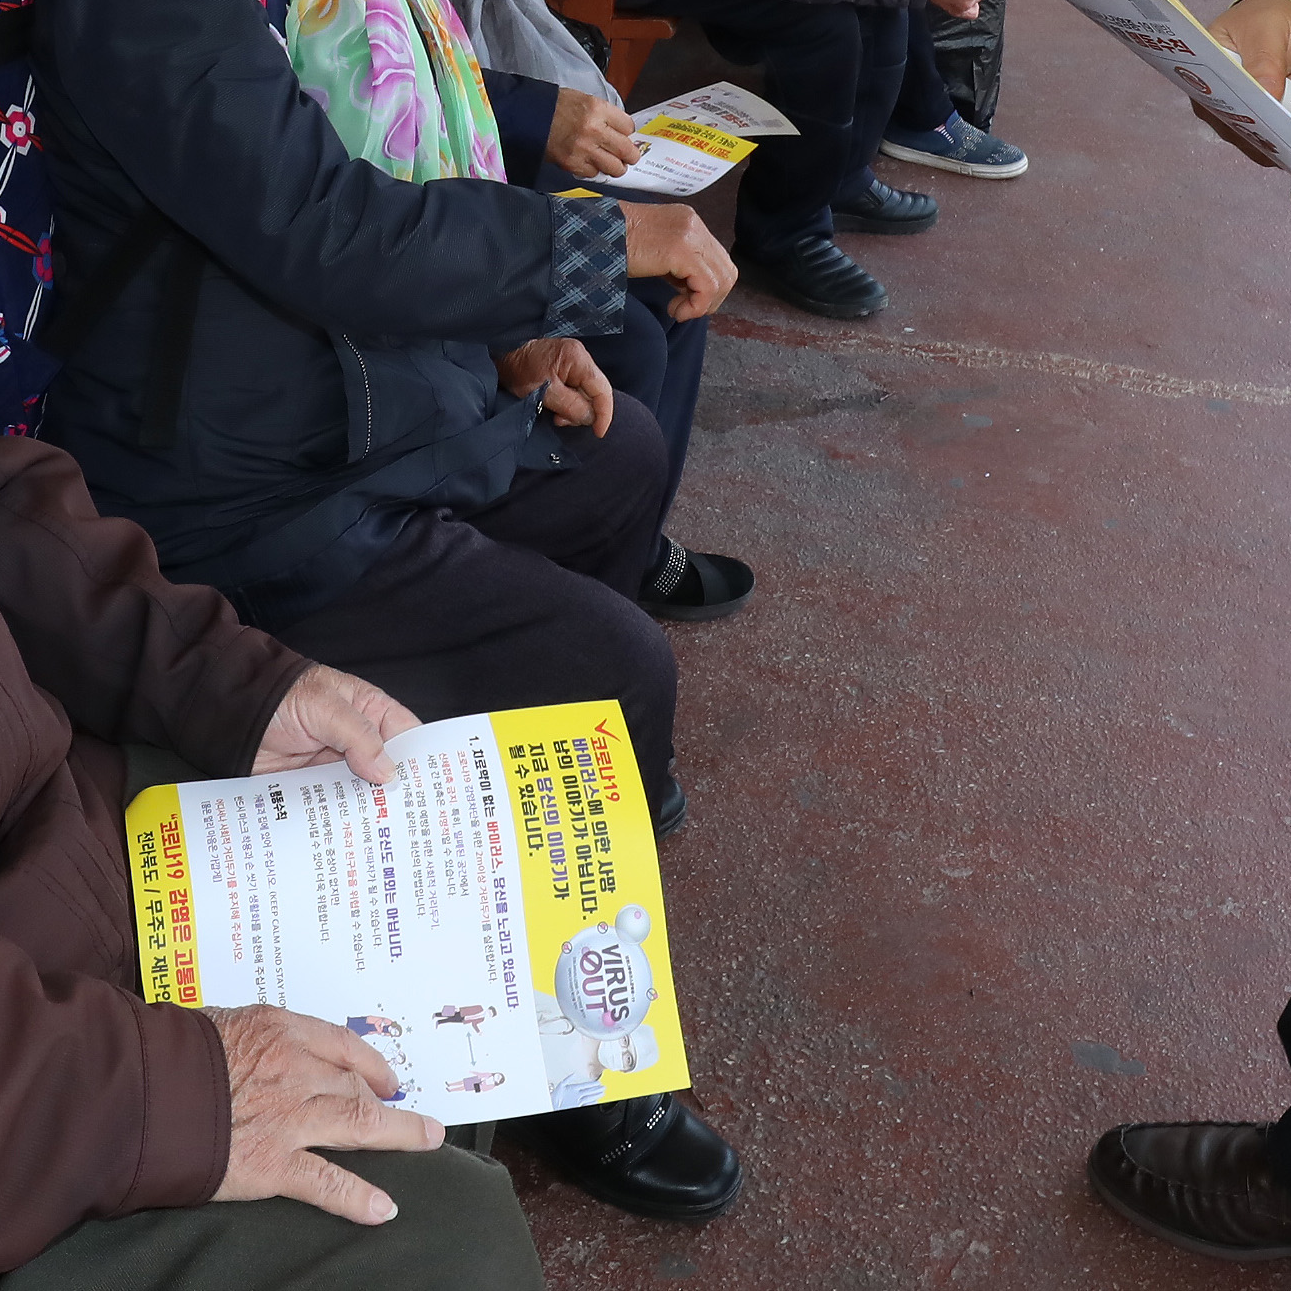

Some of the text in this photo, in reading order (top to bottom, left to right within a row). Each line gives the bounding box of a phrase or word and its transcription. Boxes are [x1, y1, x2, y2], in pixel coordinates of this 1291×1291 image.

[408, 758, 422, 788] 코로나19
[431, 771, 440, 779] 간
[456, 751, 472, 783] 코로나19
[472, 749, 491, 791] 치료약이
[590, 737, 620, 801] 코로나19
[403, 783, 414, 807] 가족을
[416, 790, 426, 807] 감염
[433, 782, 445, 806] 접촉은
[483, 795, 495, 817] 없는
[509, 745, 543, 856] 될 수 있습니다.
[406, 811, 417, 837] 살리는
[420, 810, 430, 836] 예방을
[528, 743, 569, 900] 지금 당신의 이야기가
[572, 738, 616, 893] 바이러스에 의한 사망
[261, 832, 272, 848] 있어
[342, 822, 353, 848] 가족과
[361, 817, 372, 843] 사이에
[473, 831, 483, 848] 위한
[553, 740, 598, 920] 남의 이야기가 아닙니다.
[137, 831, 159, 884] 전라북도
[312, 841, 320, 849] 수
[378, 827, 393, 863] 당신도
[411, 840, 421, 867] 최선의
[423, 840, 433, 857] 위한
[444, 848, 452, 856] 수
[487, 821, 503, 873] 바이러스,
[245, 862, 254, 870] 손
[313, 852, 323, 870] 있어
[326, 848, 337, 875] 증상이
[364, 846, 376, 882] 전파자가
[426, 861, 436, 887] 사회적
[476, 852, 486, 883] 2m이상
[316, 873, 325, 891] 더욱
[329, 878, 340, 905] 없지만
[383, 867, 396, 904] 예외는
[445, 859, 456, 898] 있습니다.
[457, 860, 469, 896] 공간에서
[269, 891, 278, 916] (KEEP
[369, 897, 378, 906] 수
[479, 887, 491, 931] 거리두기를
[494, 877, 507, 914] 당신을
[146, 900, 167, 949] 무주군
[168, 888, 191, 942] 감염은
[272, 919, 280, 943] CALM
[387, 908, 402, 962] 아닙니다.
[498, 918, 512, 955] 노리고
[174, 948, 198, 1005] 고통의
[276, 968, 284, 989] STAY
[502, 958, 519, 1012] 있습니다.
[601, 944, 629, 1023] VIRUS
[278, 992, 286, 1010] HO
